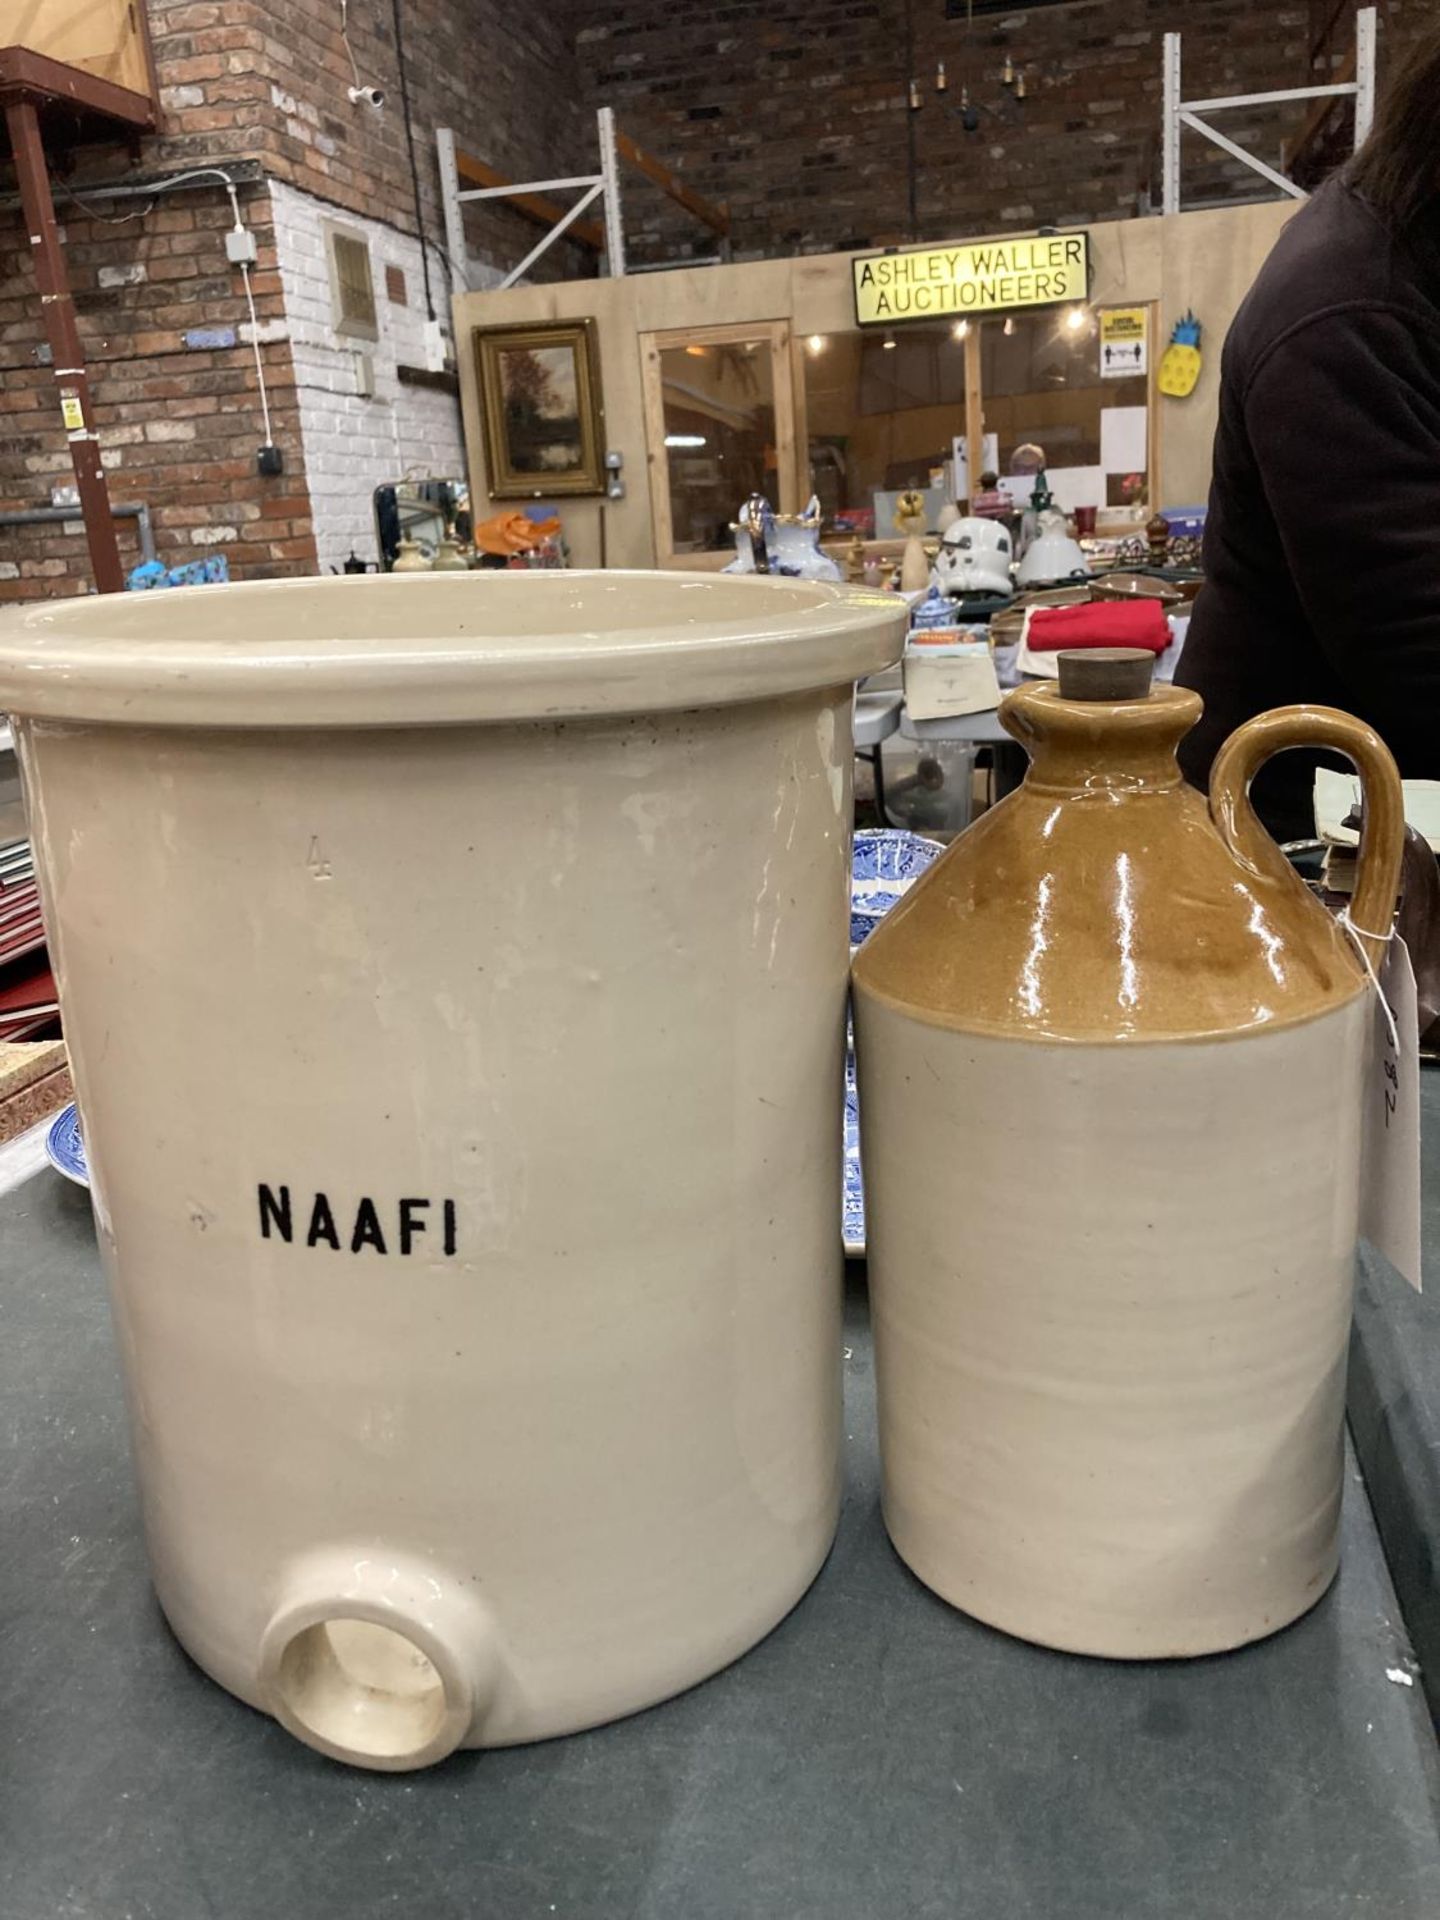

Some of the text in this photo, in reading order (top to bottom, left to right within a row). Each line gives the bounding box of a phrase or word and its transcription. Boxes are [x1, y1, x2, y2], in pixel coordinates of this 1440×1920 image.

[860, 239, 1082, 289] ASHLEY WALLER
[876, 271, 1067, 315] AUCTIONEERS
[257, 1183, 457, 1256] NAAFI
